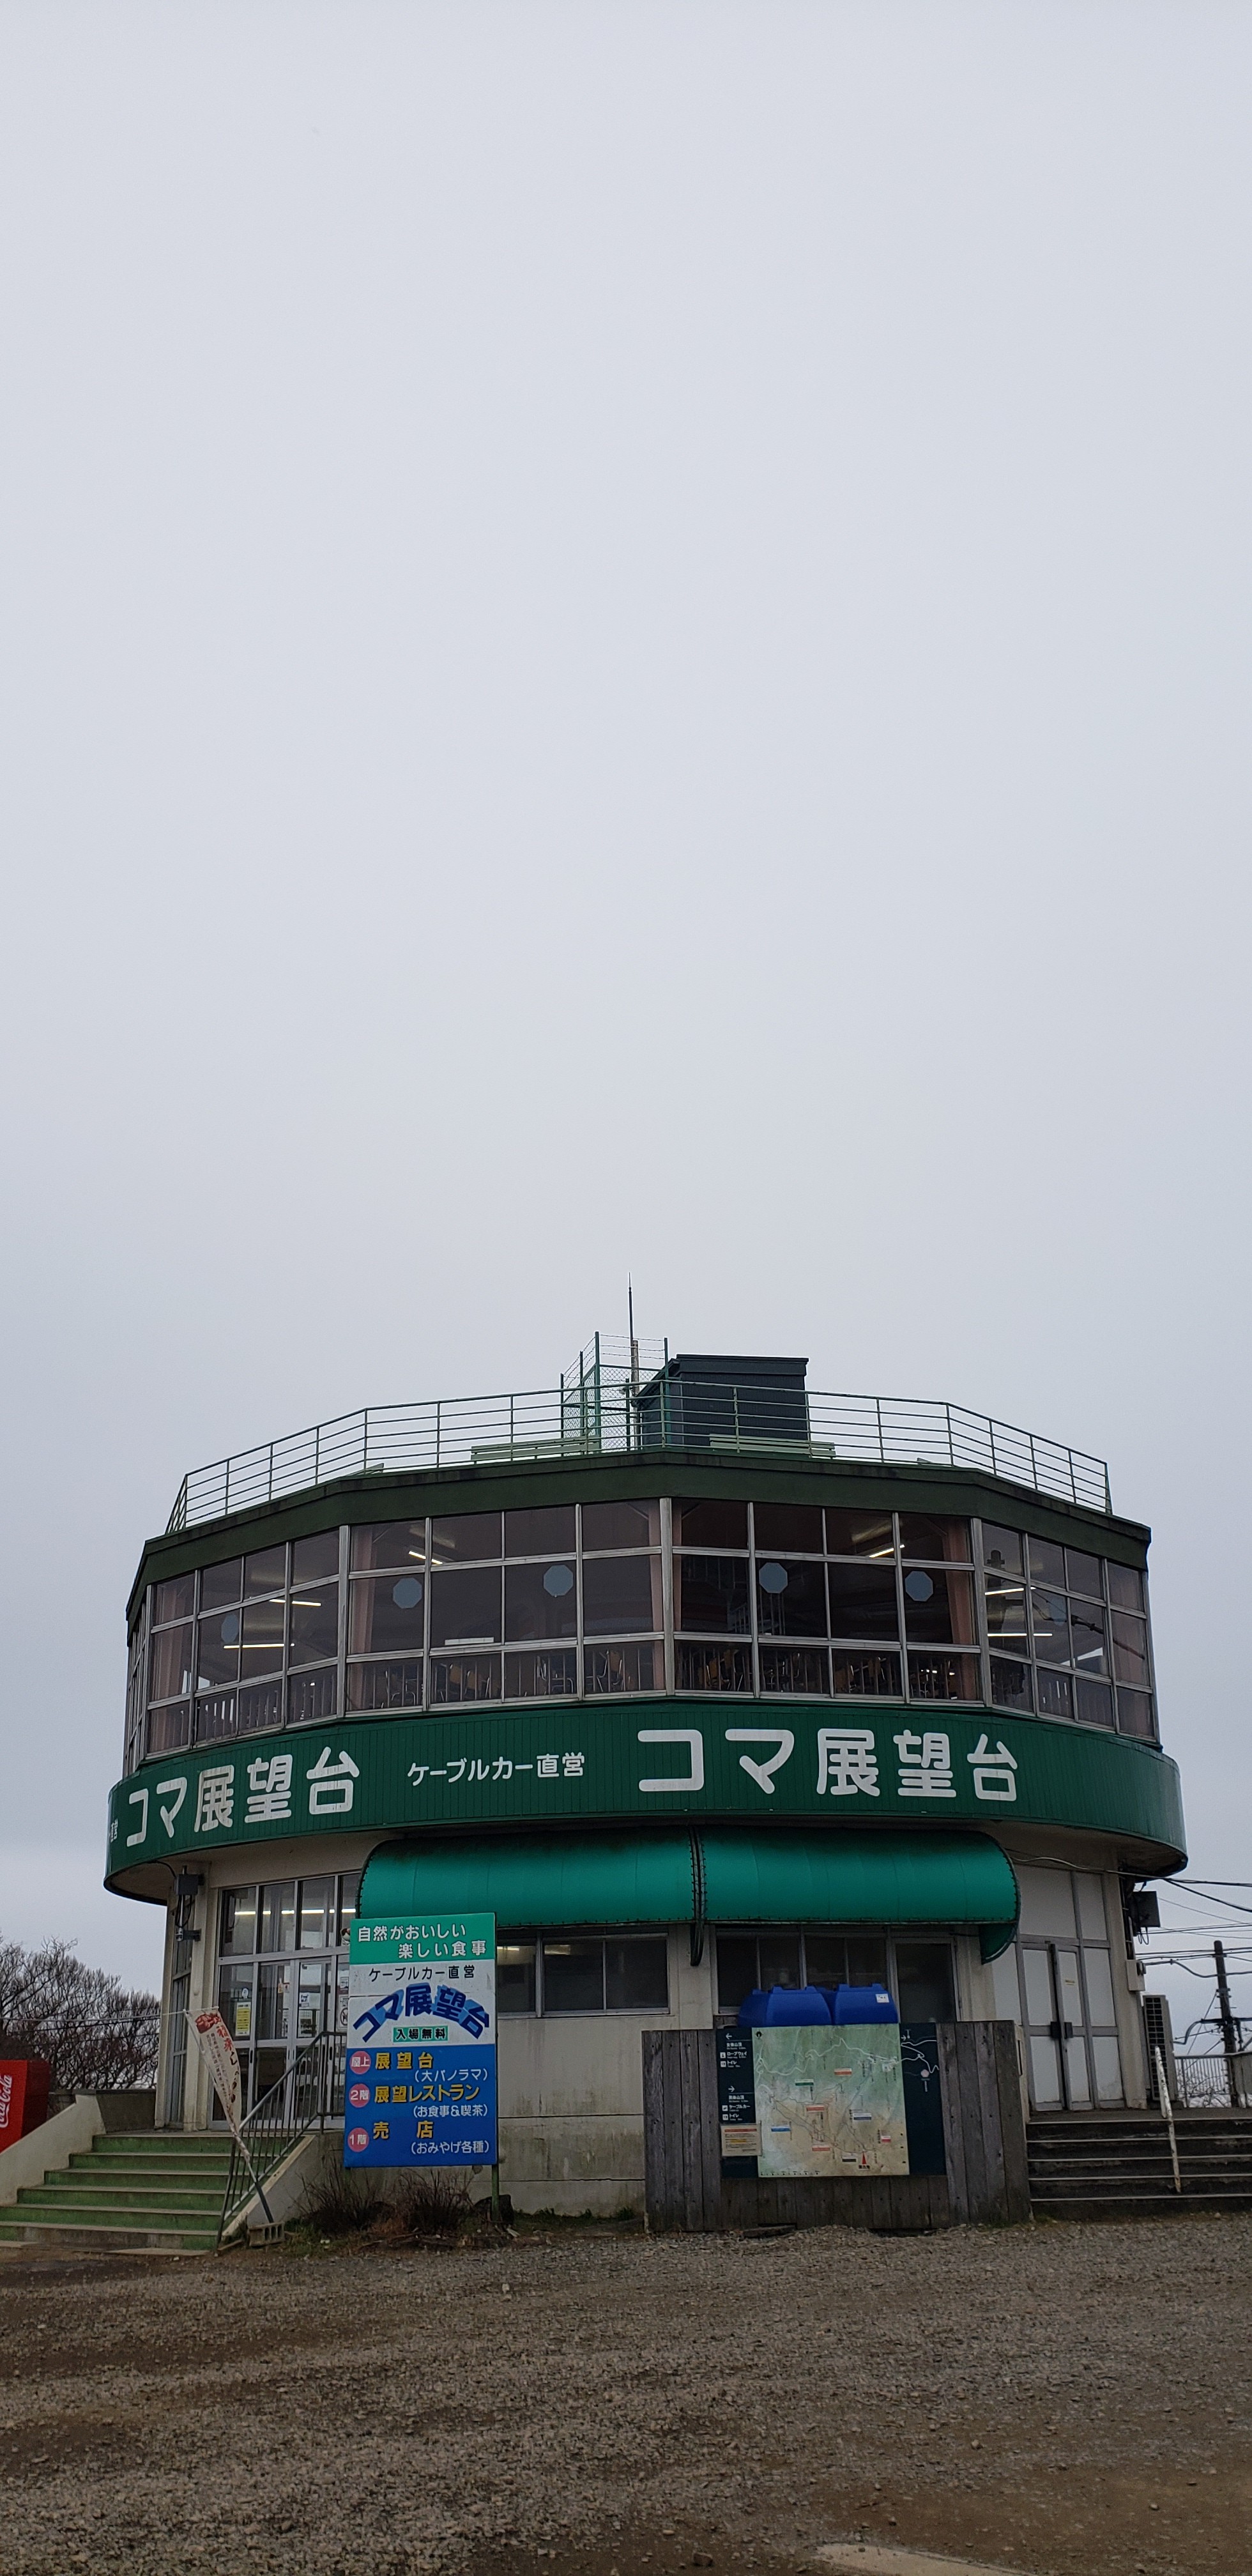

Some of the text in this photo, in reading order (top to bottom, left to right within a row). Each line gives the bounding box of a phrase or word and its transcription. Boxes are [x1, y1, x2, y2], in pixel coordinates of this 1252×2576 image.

[407, 1752, 585, 1786] ケーブルカー直営
[637, 1728, 1018, 1802] コマ展望台
[126, 1746, 360, 1847] コマ展望台
[358, 1923, 466, 1942] 自然がおいしい
[398, 1939, 487, 1959] 楽しい食事
[369, 1964, 475, 1982] ケーブルカー直営
[353, 1982, 490, 2043] コマ展望台
[395, 2028, 446, 2041] 入場無料
[374, 2051, 433, 2070] 展望台
[350, 2084, 480, 2103] 2階 展望レストラン
